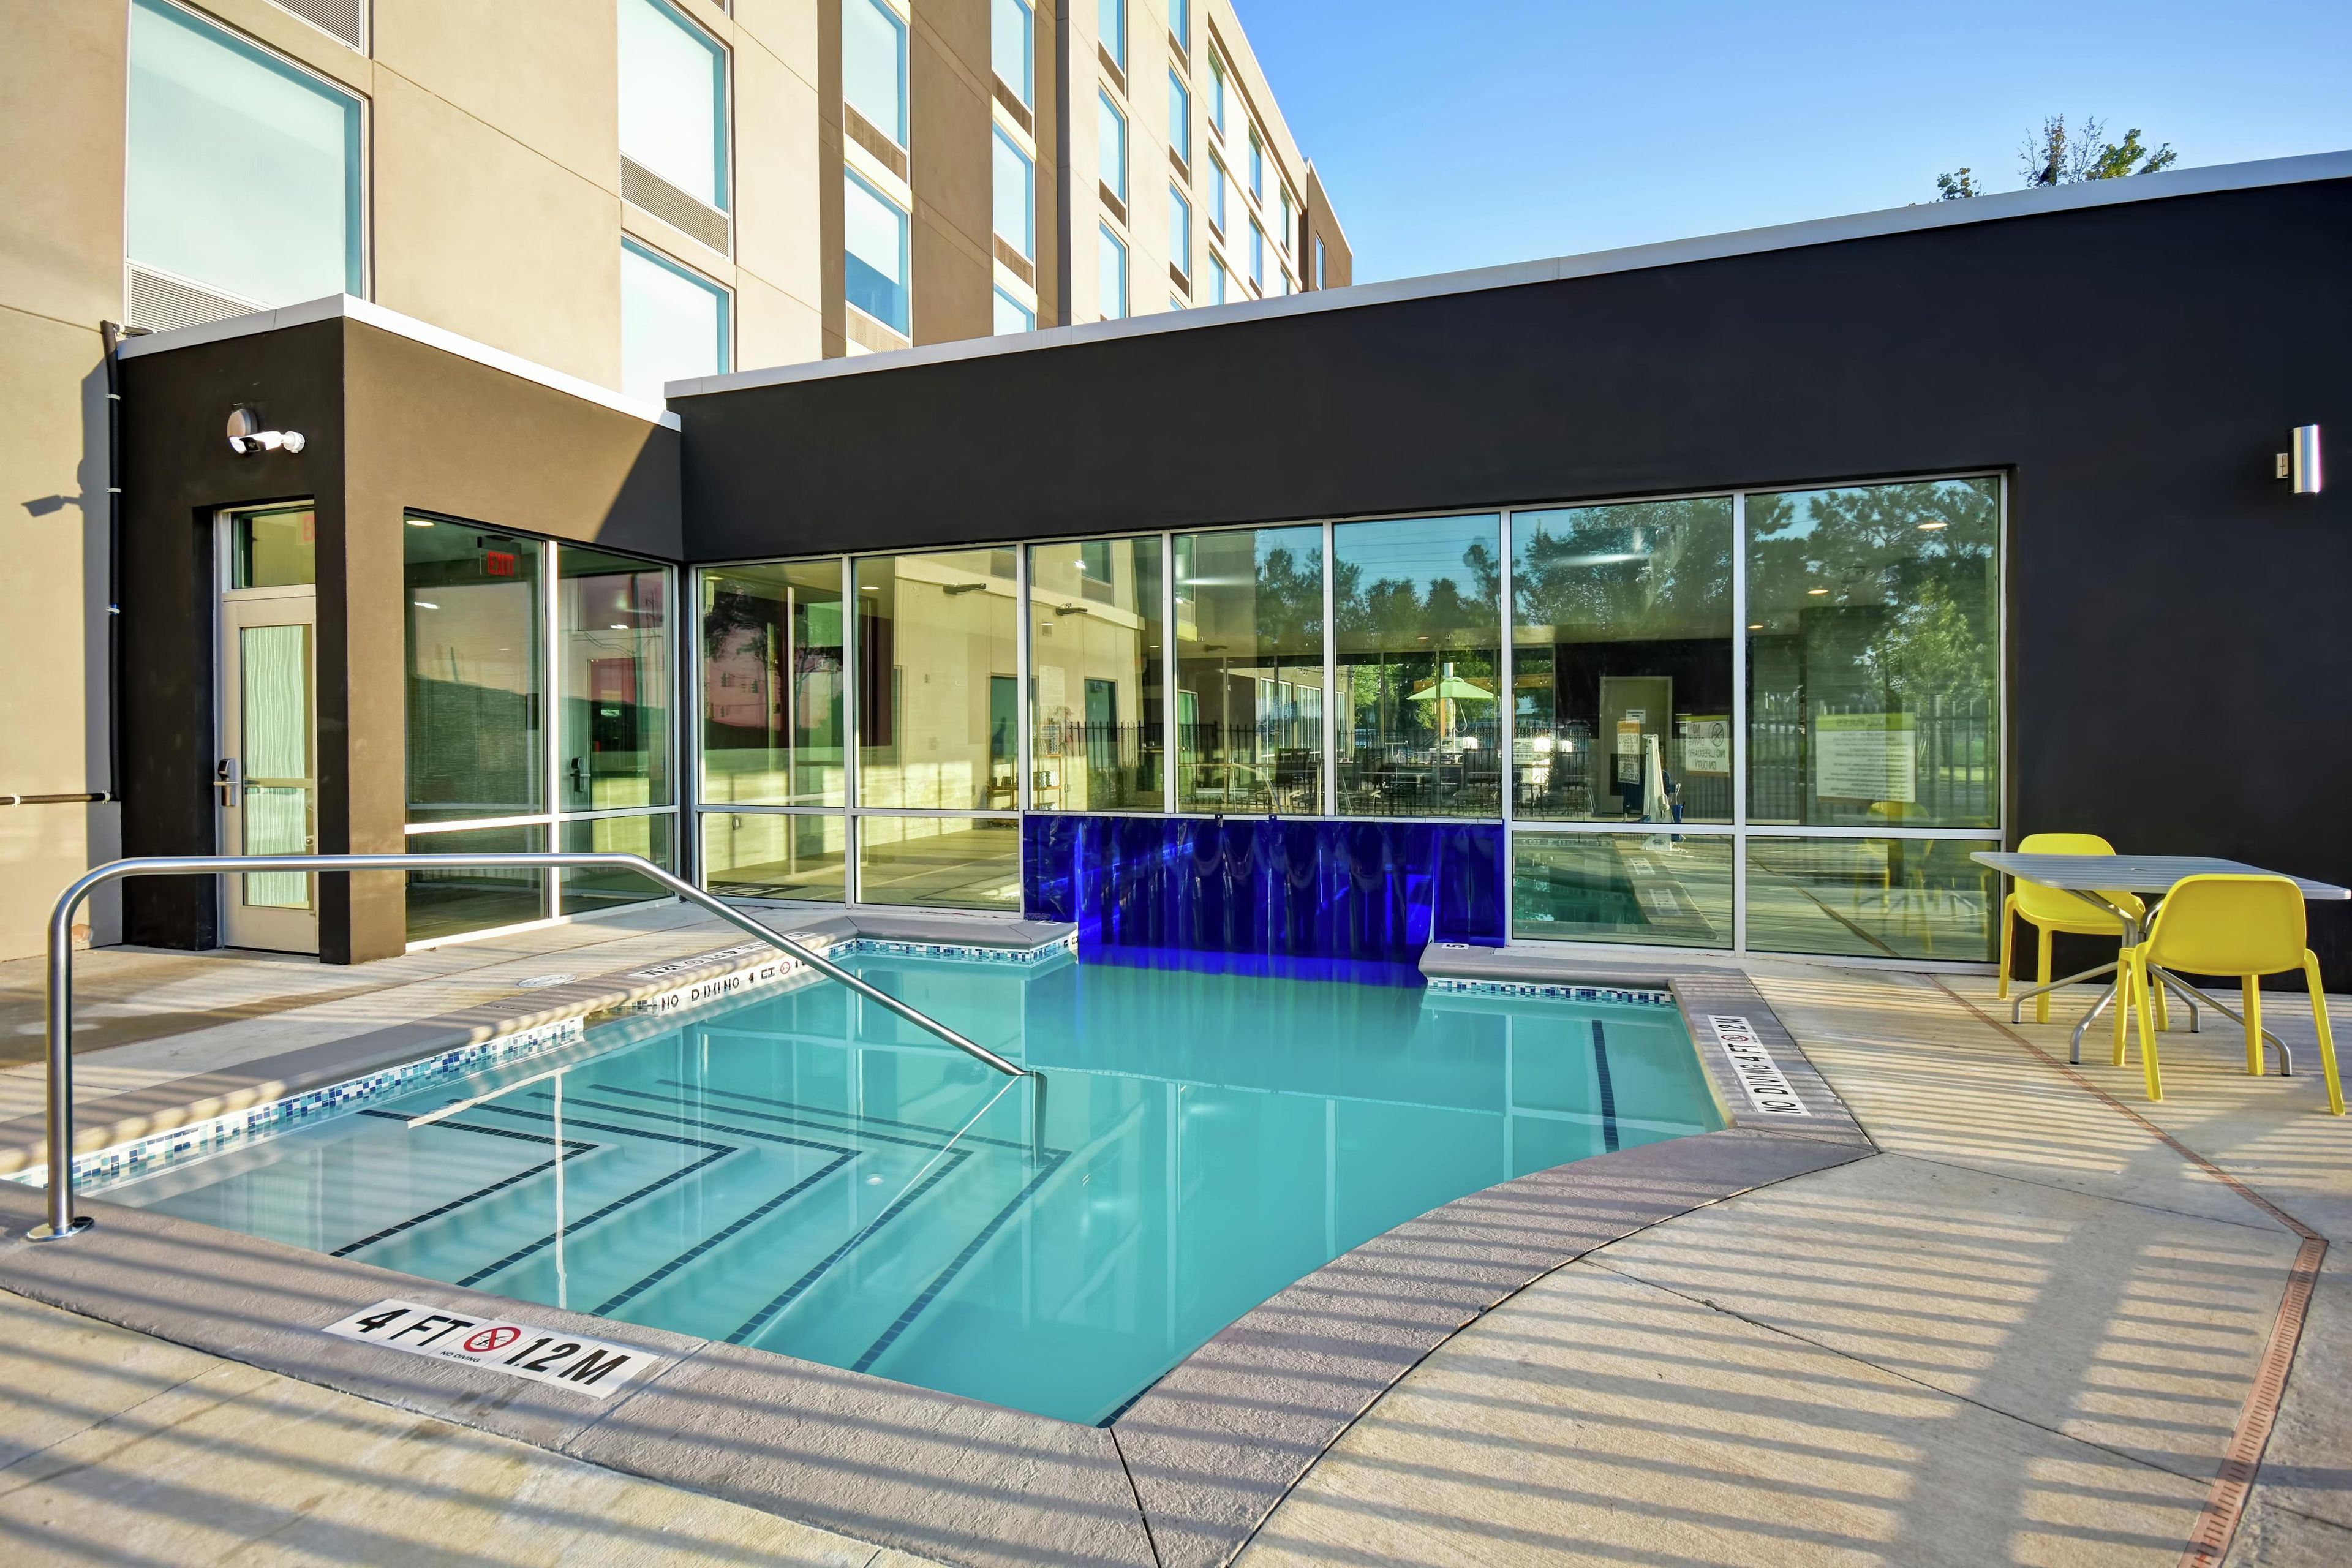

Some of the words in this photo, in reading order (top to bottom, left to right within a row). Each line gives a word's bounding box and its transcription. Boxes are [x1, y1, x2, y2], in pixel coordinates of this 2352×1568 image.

[488, 551, 514, 576] EXIT
[1739, 1064, 1789, 1095] DIVING
[1761, 1101, 1801, 1114] NO
[356, 1308, 412, 1333] 4
[388, 1315, 475, 1347] FT
[453, 1354, 481, 1363] DIVING
